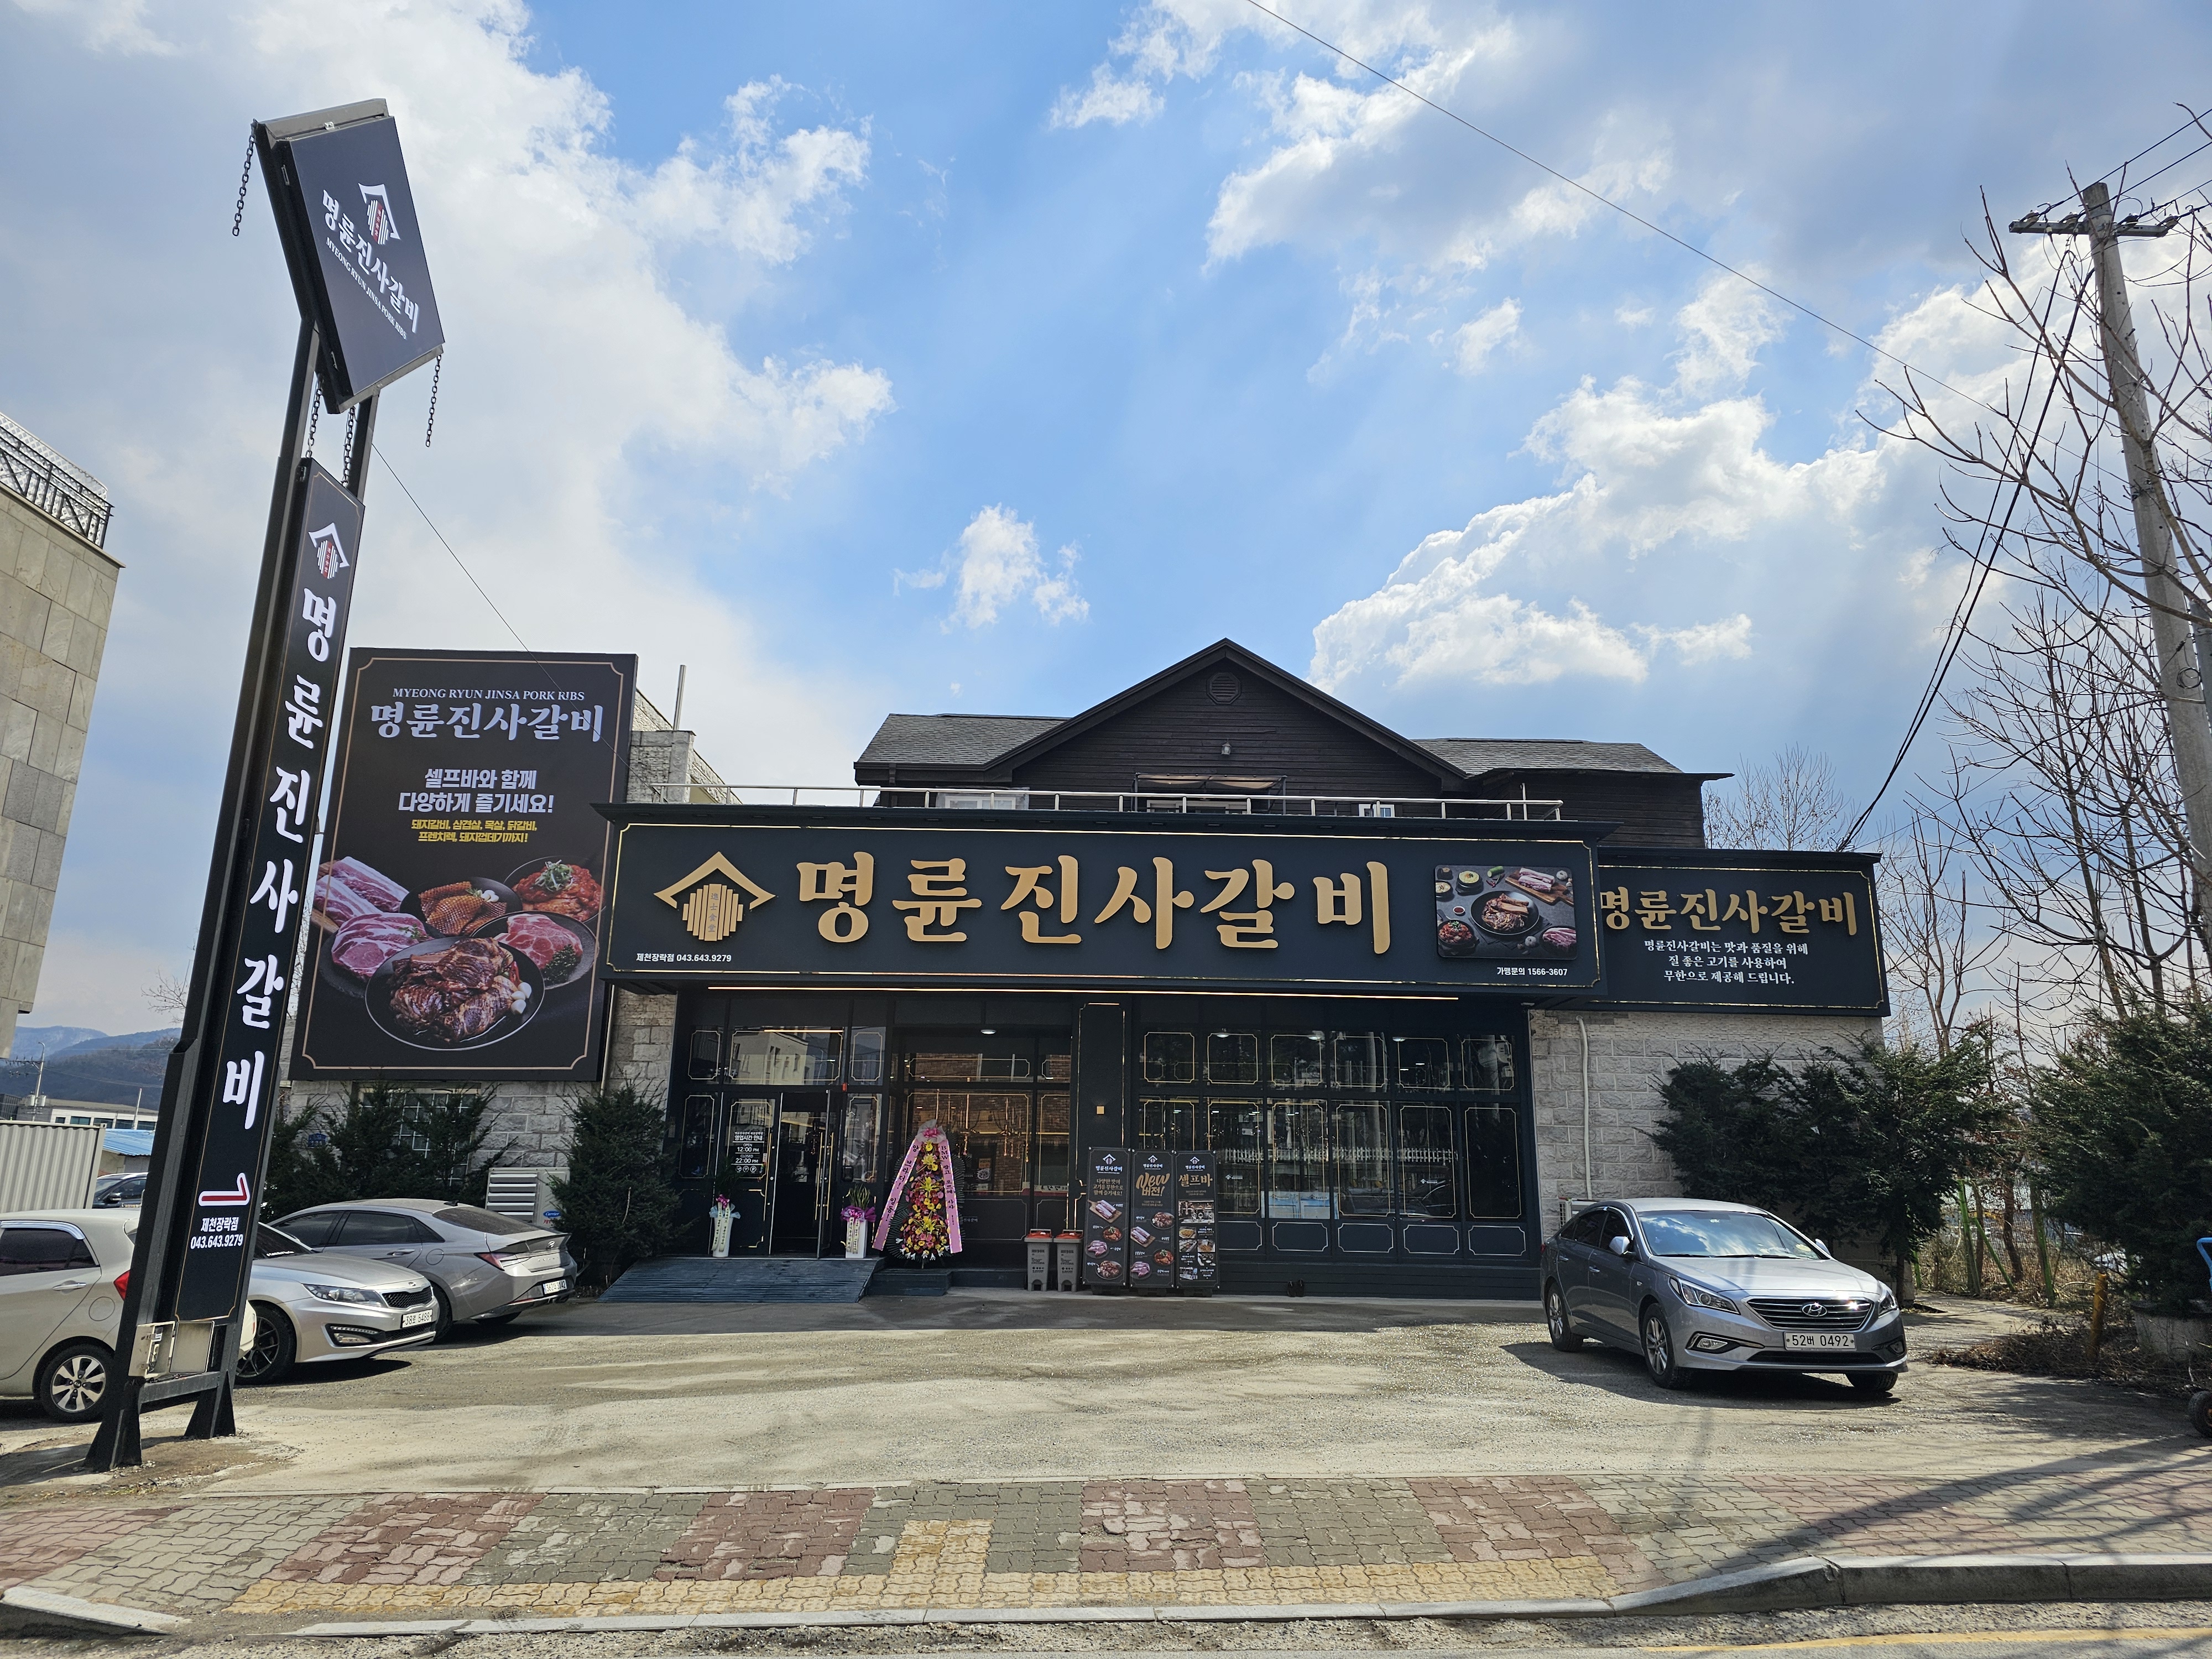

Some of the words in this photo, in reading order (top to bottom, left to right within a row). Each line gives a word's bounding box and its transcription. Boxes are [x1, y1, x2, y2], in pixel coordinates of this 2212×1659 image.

[322, 189, 419, 333] 명륜진사갈비
[326, 237, 351, 272] MYEONG
[351, 266, 366, 290] RYUN
[366, 286, 381, 310] JINSA
[381, 304, 395, 326] PORK
[394, 320, 407, 340] RIBS
[393, 688, 446, 698] MYEONG
[448, 689, 483, 698] RYUN
[485, 690, 520, 700] JINSA
[523, 691, 555, 700] PORK
[557, 691, 585, 701] RIBS
[371, 702, 603, 742] 명륜진사갈비
[425, 769, 498, 789] 셀프바와
[501, 769, 537, 789] 함께
[398, 792, 471, 812] 다양하게
[475, 793, 554, 813] 즐기세요!
[411, 819, 451, 830] 돼지갈비,
[452, 820, 483, 831] 삼겹살,
[484, 820, 505, 831] 목살,
[507, 821, 538, 831] 닭갈비,
[459, 832, 528, 842] 돼지껍데기까지!
[222, 588, 336, 1130] 명륜진사갈비
[796, 851, 1392, 954] 명륜진사갈비
[1600, 886, 1857, 936] 명륜진사갈비
[1644, 939, 1721, 953] 명륜진사갈비는
[1724, 941, 1749, 954] 맛과
[1750, 942, 1783, 954] 품질을
[1786, 942, 1808, 955] 위해
[636, 953, 674, 962] 제천장락점
[676, 954, 732, 962] 043.643.9279
[1668, 955, 1679, 967] 질
[1682, 955, 1704, 967] 좋은
[1707, 956, 1739, 968] 고기를
[1741, 957, 1787, 969] 사용하여
[1496, 967, 1525, 975] 가맹문의
[1527, 968, 1568, 976] 1566-3607
[1663, 969, 1709, 982] 무한으로
[1710, 971, 1744, 983] 제공해
[1747, 972, 1795, 984] 드립니다.
[1135, 1172, 1170, 1189] New
[1178, 1173, 1213, 1187] 셀프바
[1141, 1186, 1165, 1197] 버전!
[201, 1217, 239, 1232] 제천장락점
[190, 1234, 243, 1249] 043.643.9279
[418, 1312, 430, 1322] 5488
[1792, 1334, 1814, 1345] 52버
[1820, 1335, 1849, 1346] 0492
